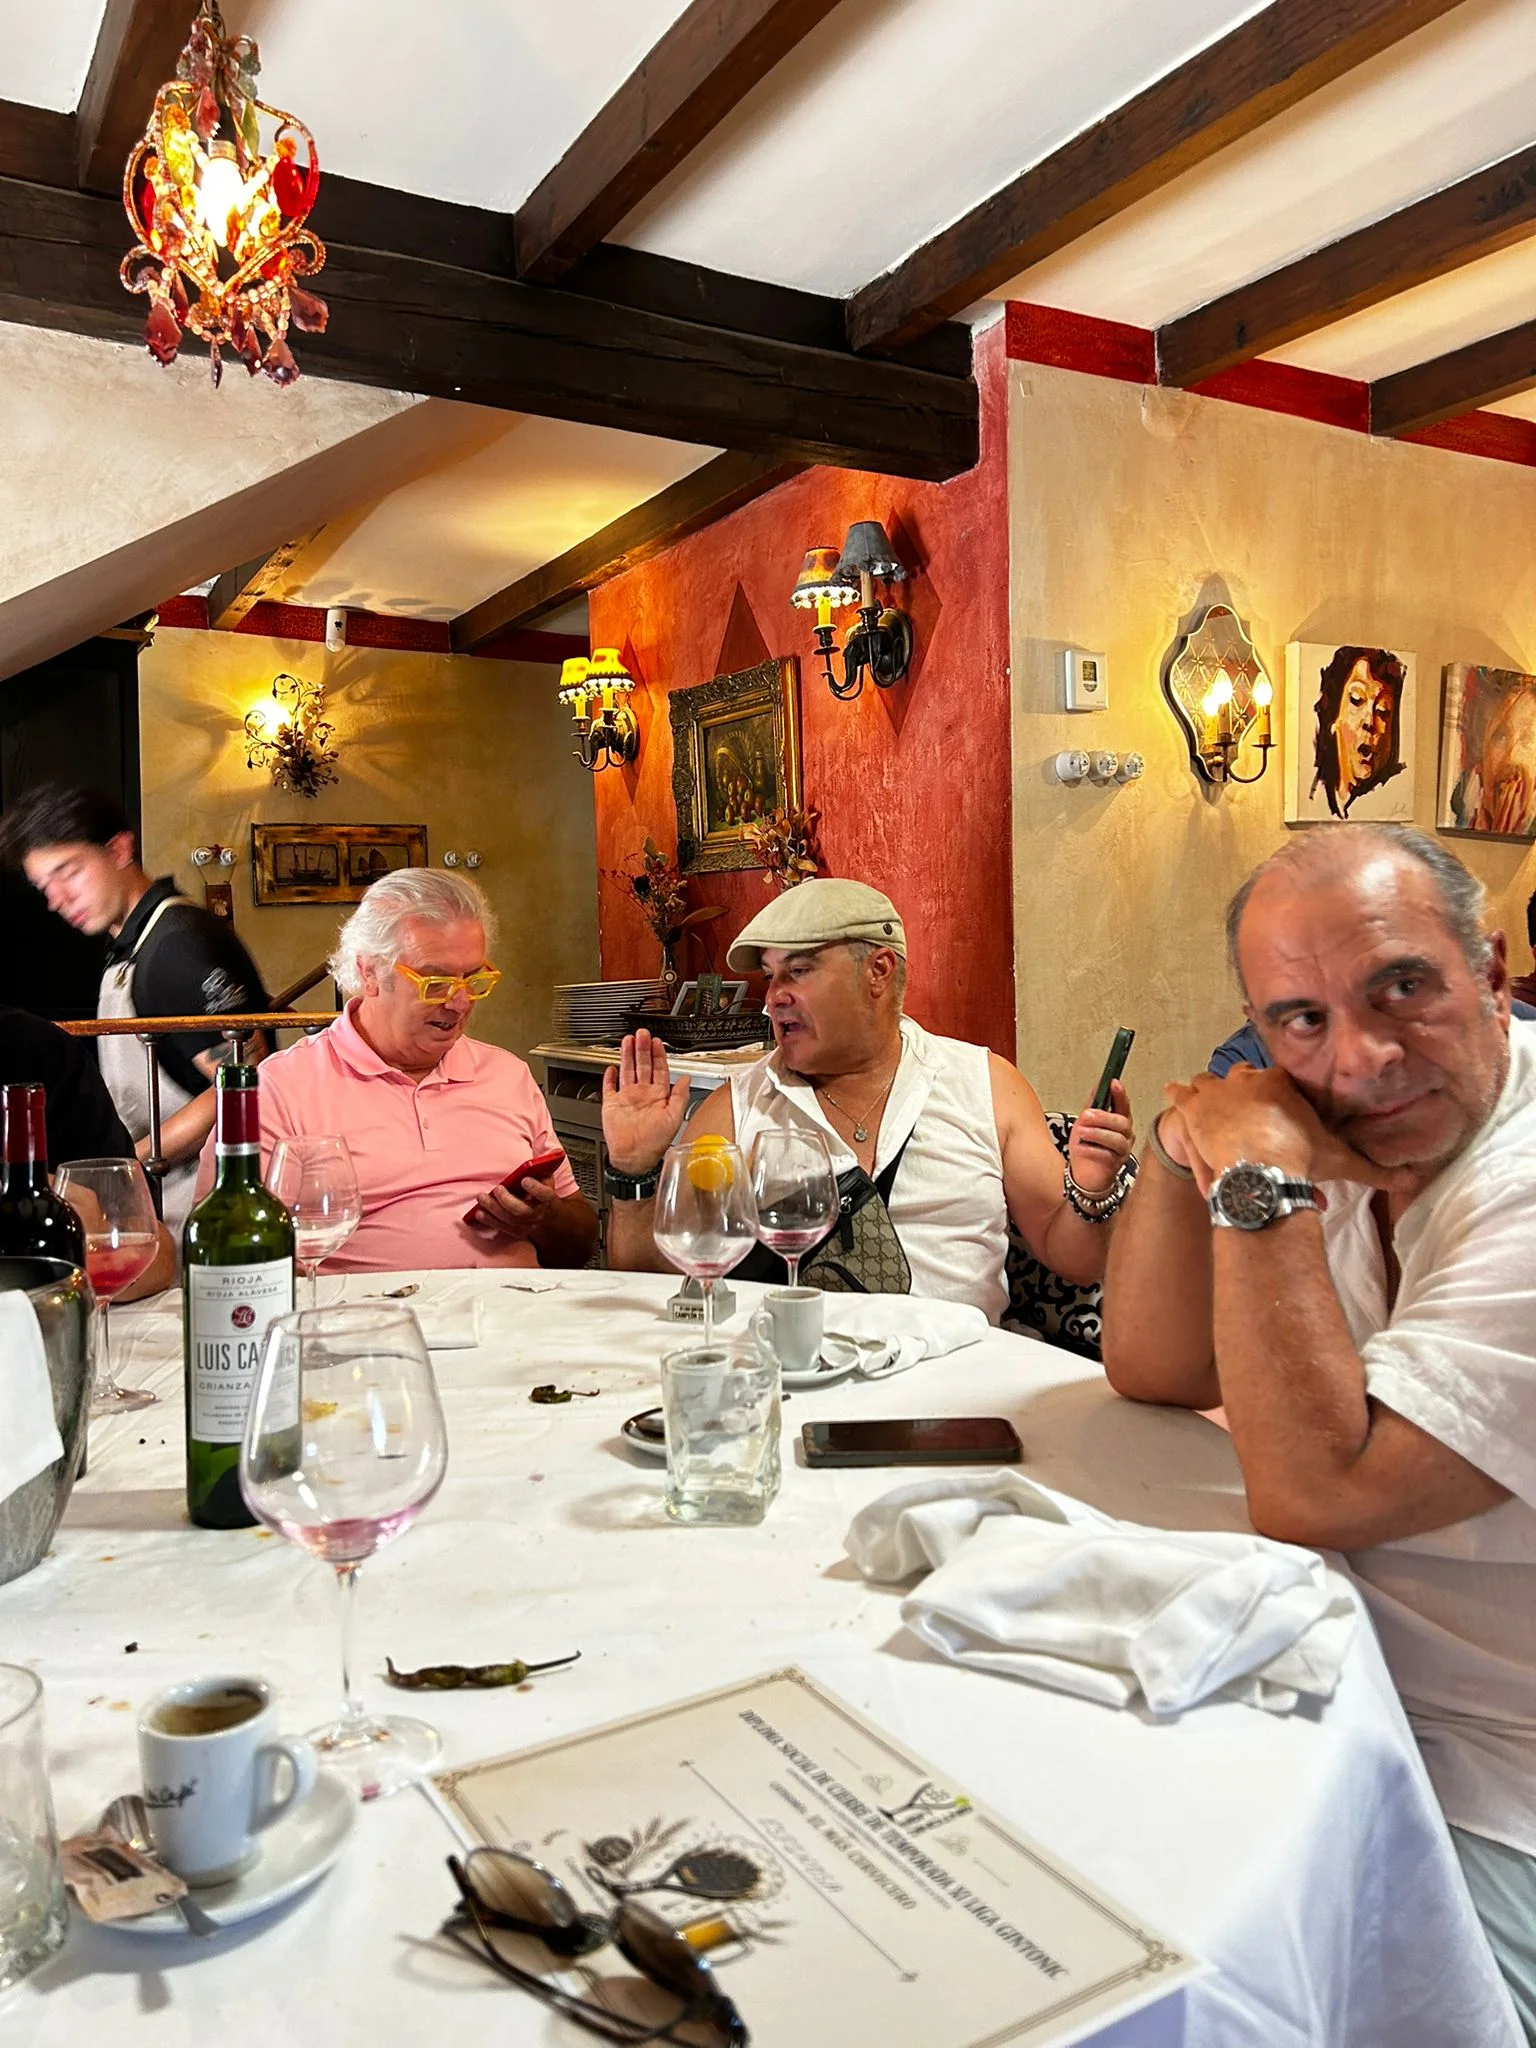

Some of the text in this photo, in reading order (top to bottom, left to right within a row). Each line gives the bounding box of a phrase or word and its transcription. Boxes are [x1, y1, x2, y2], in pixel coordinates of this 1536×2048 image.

[222, 1275, 264, 1285] RIOJA
[206, 1286, 278, 1298] RIOJA ALAVESA
[197, 1342, 231, 1371] LUIS
[199, 1381, 251, 1390] CRIANZA
[739, 1709, 784, 1746] DIPLOMA
[777, 1741, 819, 1777] SOCIAL
[811, 1769, 835, 1786] DE
[827, 1782, 872, 1819] CIERRE
[864, 1813, 888, 1831] DE
[880, 1828, 954, 1889] TEMPORADA
[950, 1885, 971, 1901] XI
[963, 1897, 1001, 1927] LIGA
[995, 1923, 1069, 1980] GINTONIC
